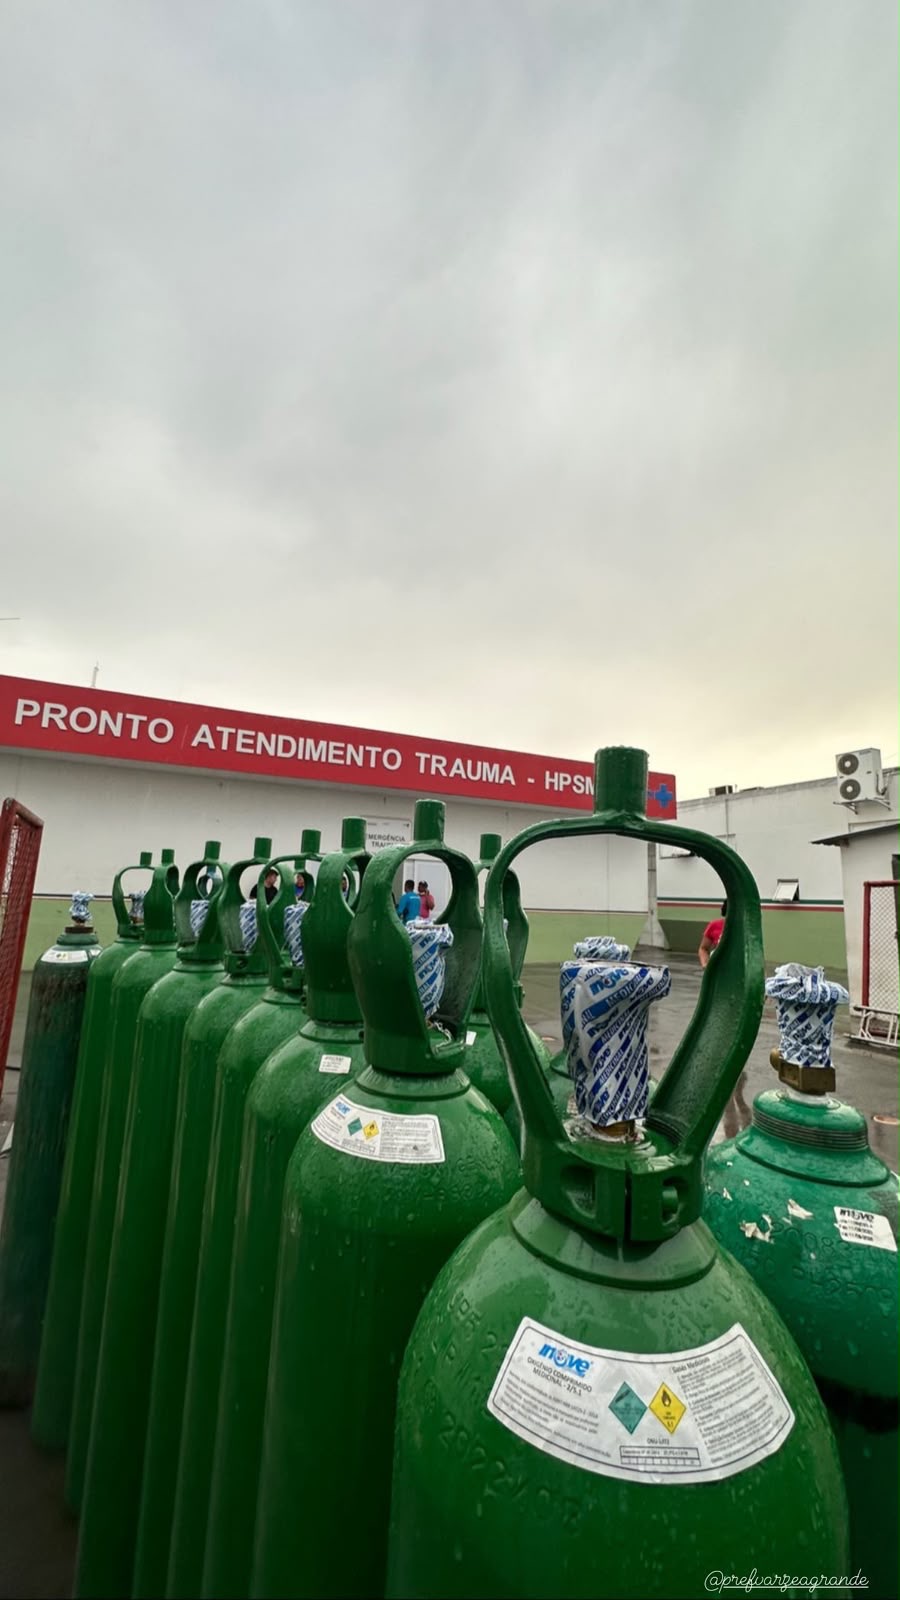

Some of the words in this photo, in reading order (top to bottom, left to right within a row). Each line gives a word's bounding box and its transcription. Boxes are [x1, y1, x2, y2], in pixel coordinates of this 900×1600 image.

[14, 698, 174, 744] PRONTO
[191, 724, 402, 771] ATENDIMENTO
[415, 752, 516, 786] TRAUMA
[368, 833, 406, 842] MERGÊNCIA
[527, 1357, 553, 1374] OXIGÊNIO
[553, 1369, 592, 1392] COMPRIMIDO
[538, 1342, 590, 1375] inove
[533, 1367, 562, 1387] MEDICINAL
